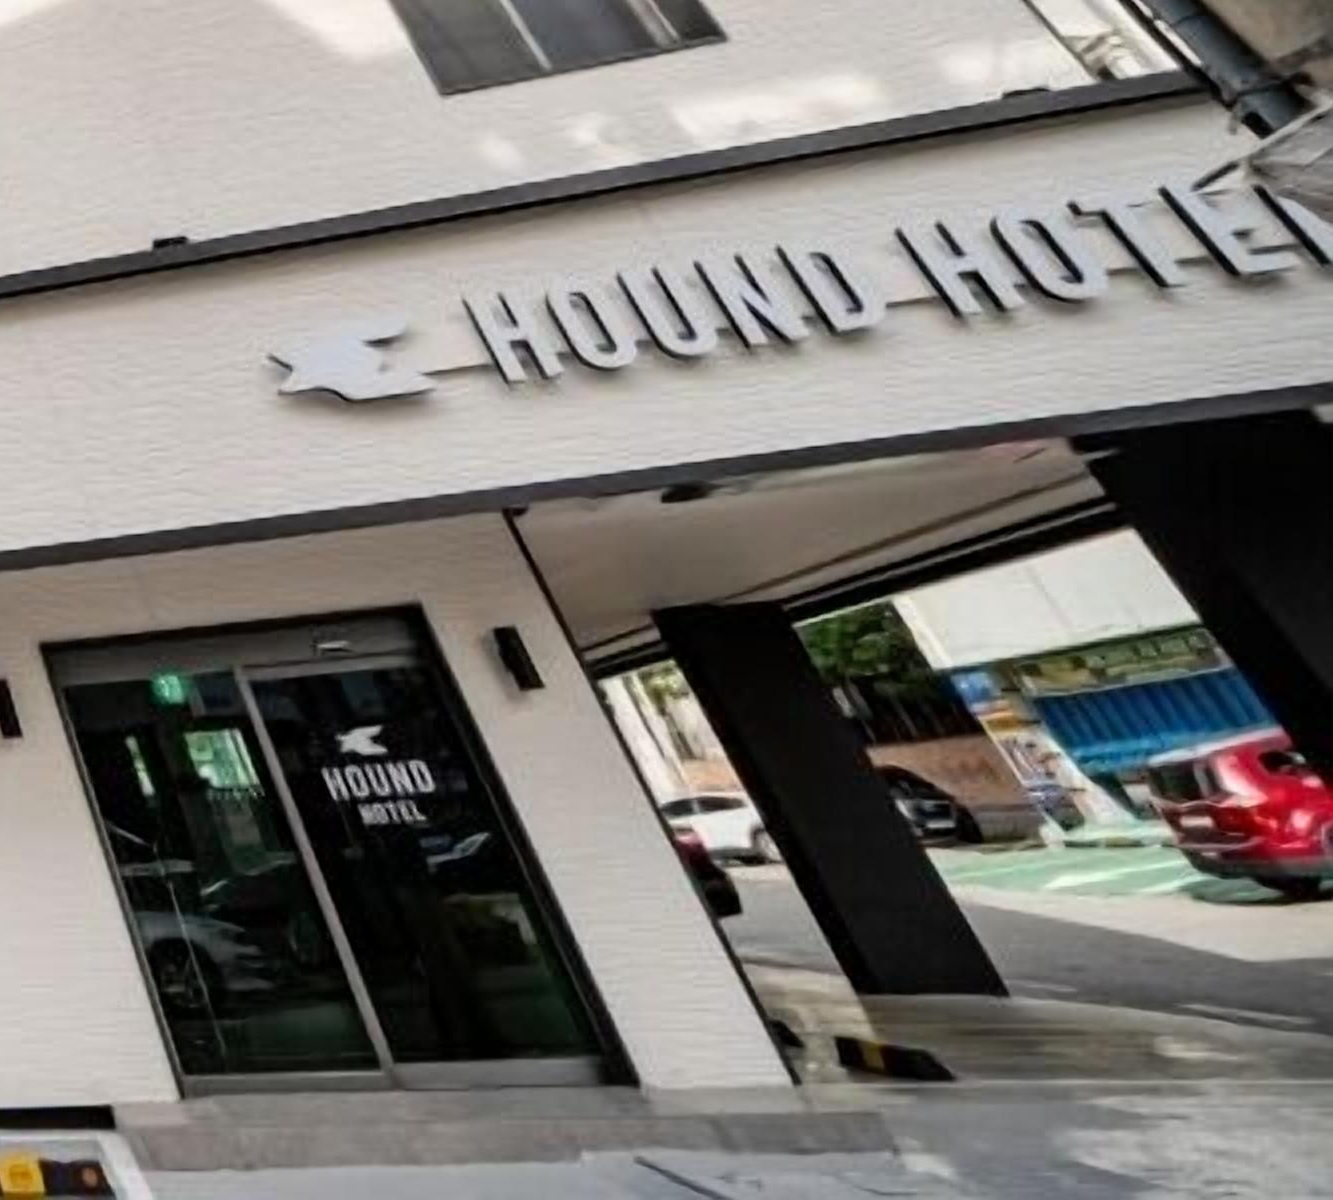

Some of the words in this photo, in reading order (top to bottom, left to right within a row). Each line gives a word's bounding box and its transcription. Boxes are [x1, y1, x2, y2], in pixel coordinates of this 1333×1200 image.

[463, 243, 889, 386] HOUND
[321, 759, 435, 803] HOUND
[357, 800, 427, 827] HOTEL
